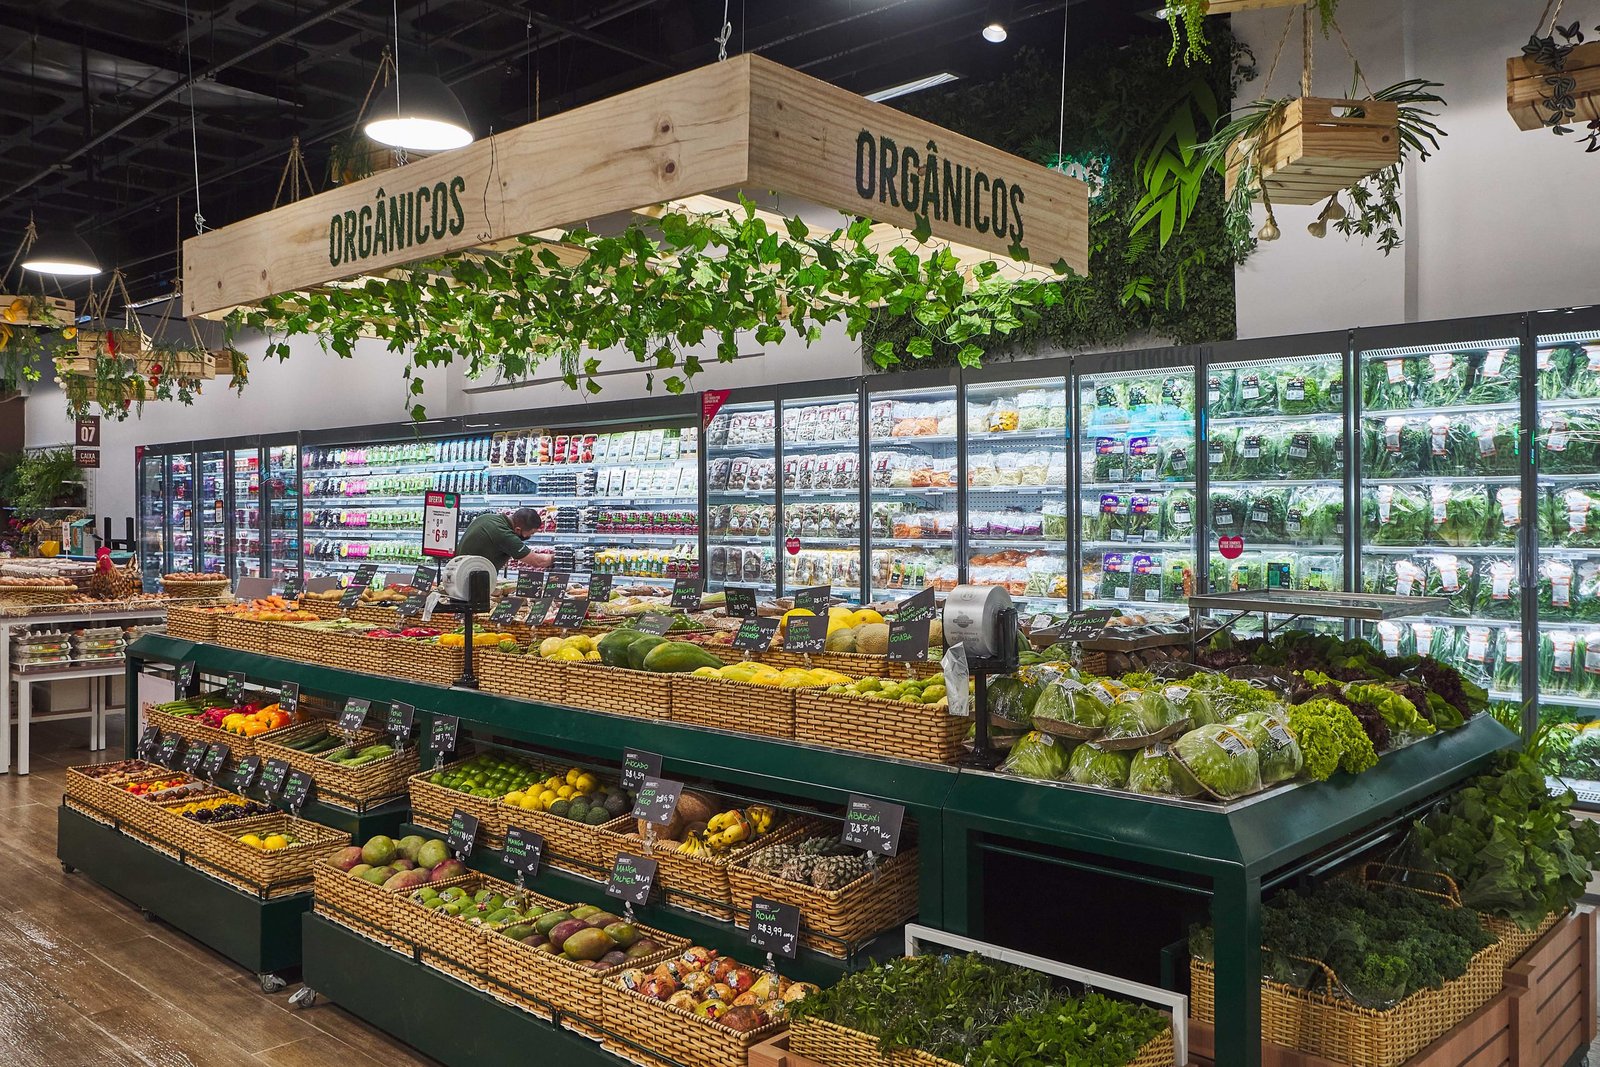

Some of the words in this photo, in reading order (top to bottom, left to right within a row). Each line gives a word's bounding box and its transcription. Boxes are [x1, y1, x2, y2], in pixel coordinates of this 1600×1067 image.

[856, 128, 1024, 244] ORGÂNICOS
[329, 175, 465, 267] ORGÂNICOS
[81, 426, 95, 442] 07
[625, 759, 649, 770] AVOCADO
[507, 837, 524, 846] MANGA
[755, 908, 780, 921] ROMÃ
